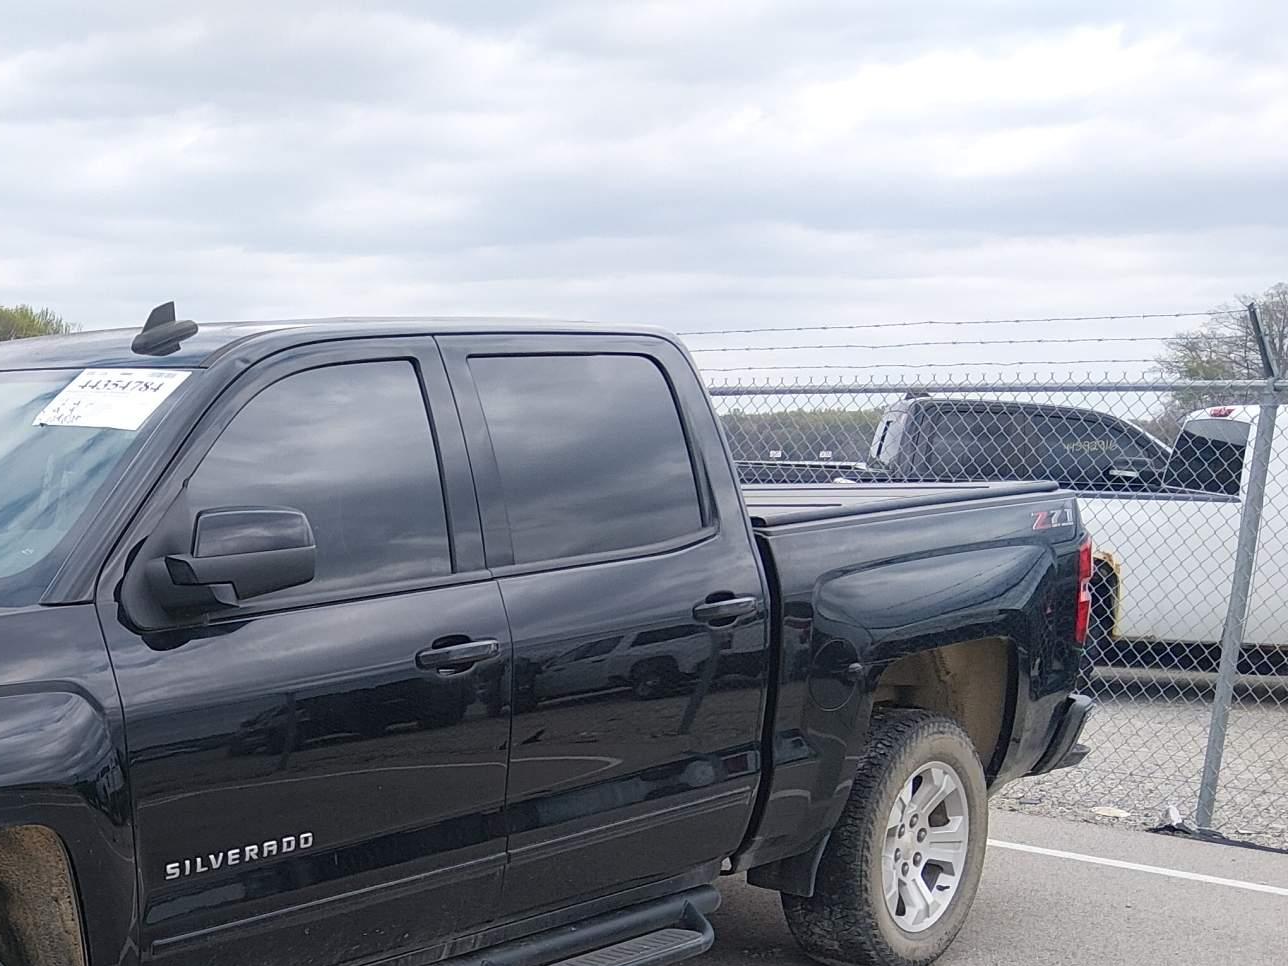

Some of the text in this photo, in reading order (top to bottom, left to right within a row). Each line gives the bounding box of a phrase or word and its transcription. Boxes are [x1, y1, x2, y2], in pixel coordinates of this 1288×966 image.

[79, 380, 164, 392] 44354784
[1032, 508, 1073, 530] Z71
[165, 832, 314, 880] SILVERADO
